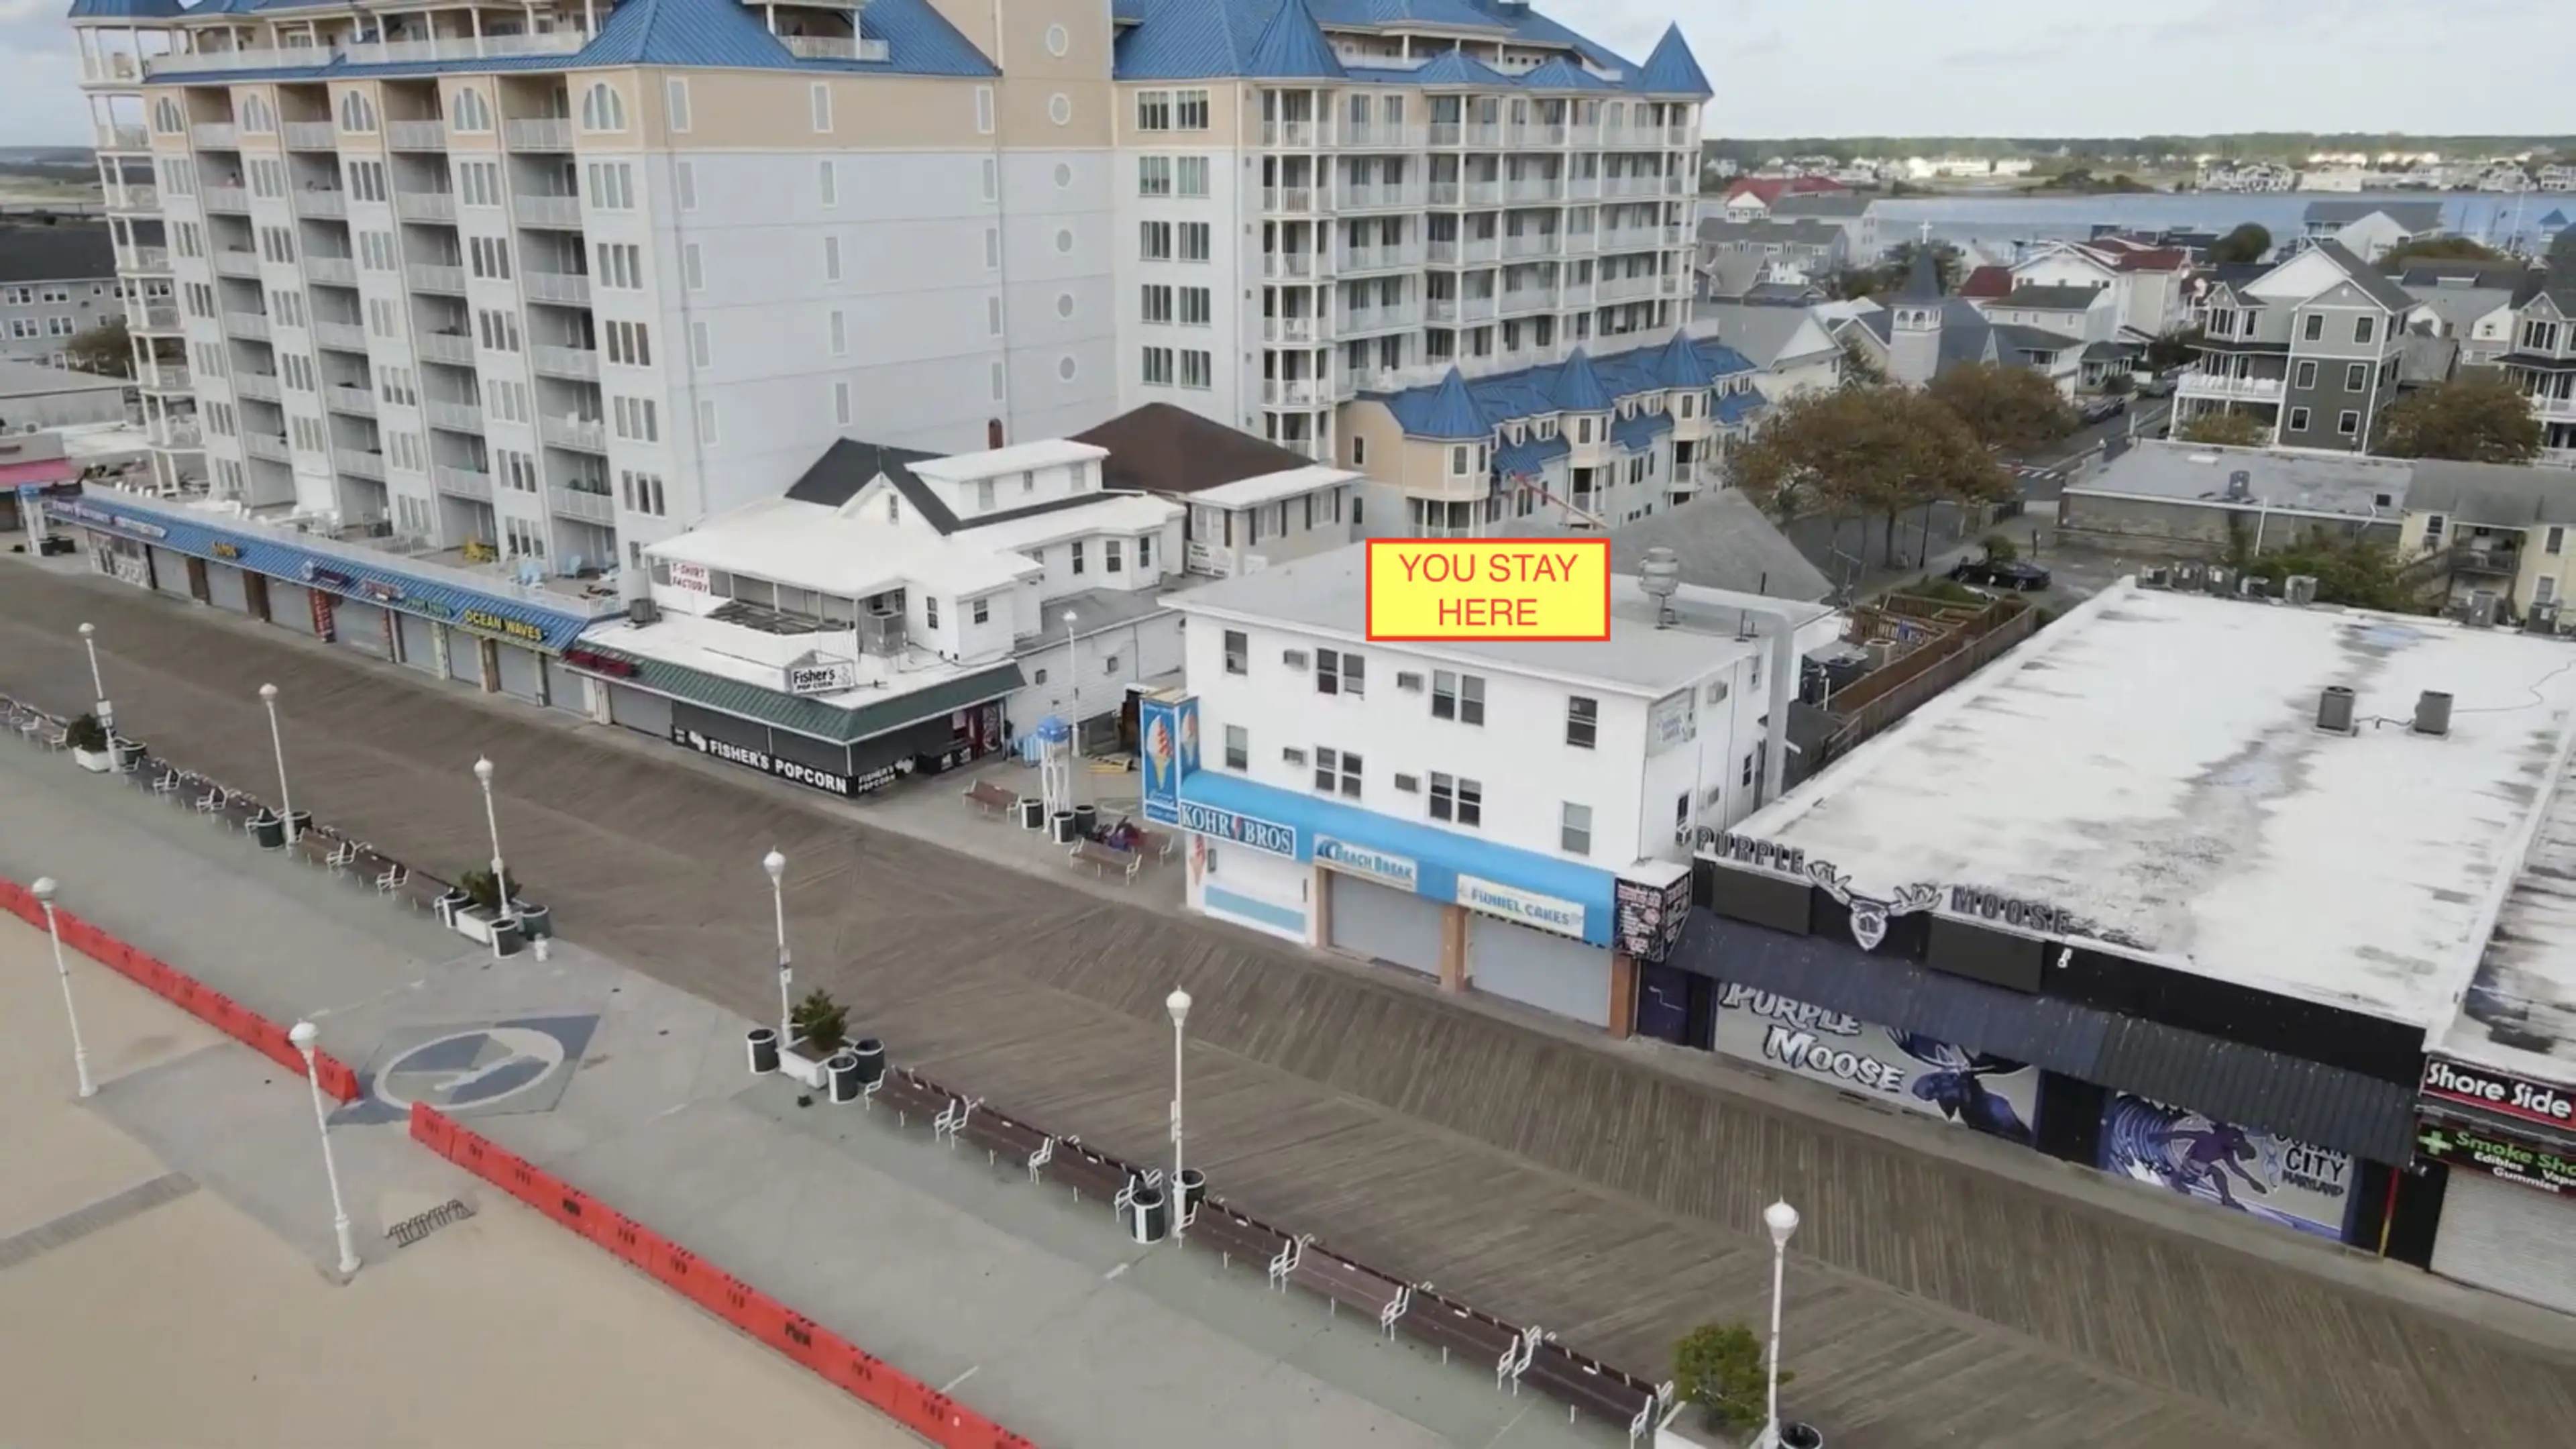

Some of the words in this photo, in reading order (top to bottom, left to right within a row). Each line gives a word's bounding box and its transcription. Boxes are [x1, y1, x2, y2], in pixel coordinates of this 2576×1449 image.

[464, 608, 502, 629] OCEAN
[505, 620, 542, 641] WAVES
[709, 739, 769, 771] FISHER'S
[774, 758, 847, 794] POPCORN
[1181, 804, 1231, 838] KOHR
[1244, 820, 1291, 853] BROS
[1696, 826, 1805, 875] PURPLE
[1951, 884, 2072, 936] MOOSE
[1471, 888, 1523, 913] FUNNEL
[1524, 903, 1570, 925] CAKES
[2426, 1062, 2506, 1101] Shore
[2510, 1083, 2572, 1118] Side
[2286, 1147, 2344, 1182] CITY
[2456, 1131, 2533, 1164] Smoke
[2473, 1151, 2524, 1172] Edibles
[2492, 1167, 2561, 1193] Gummies
